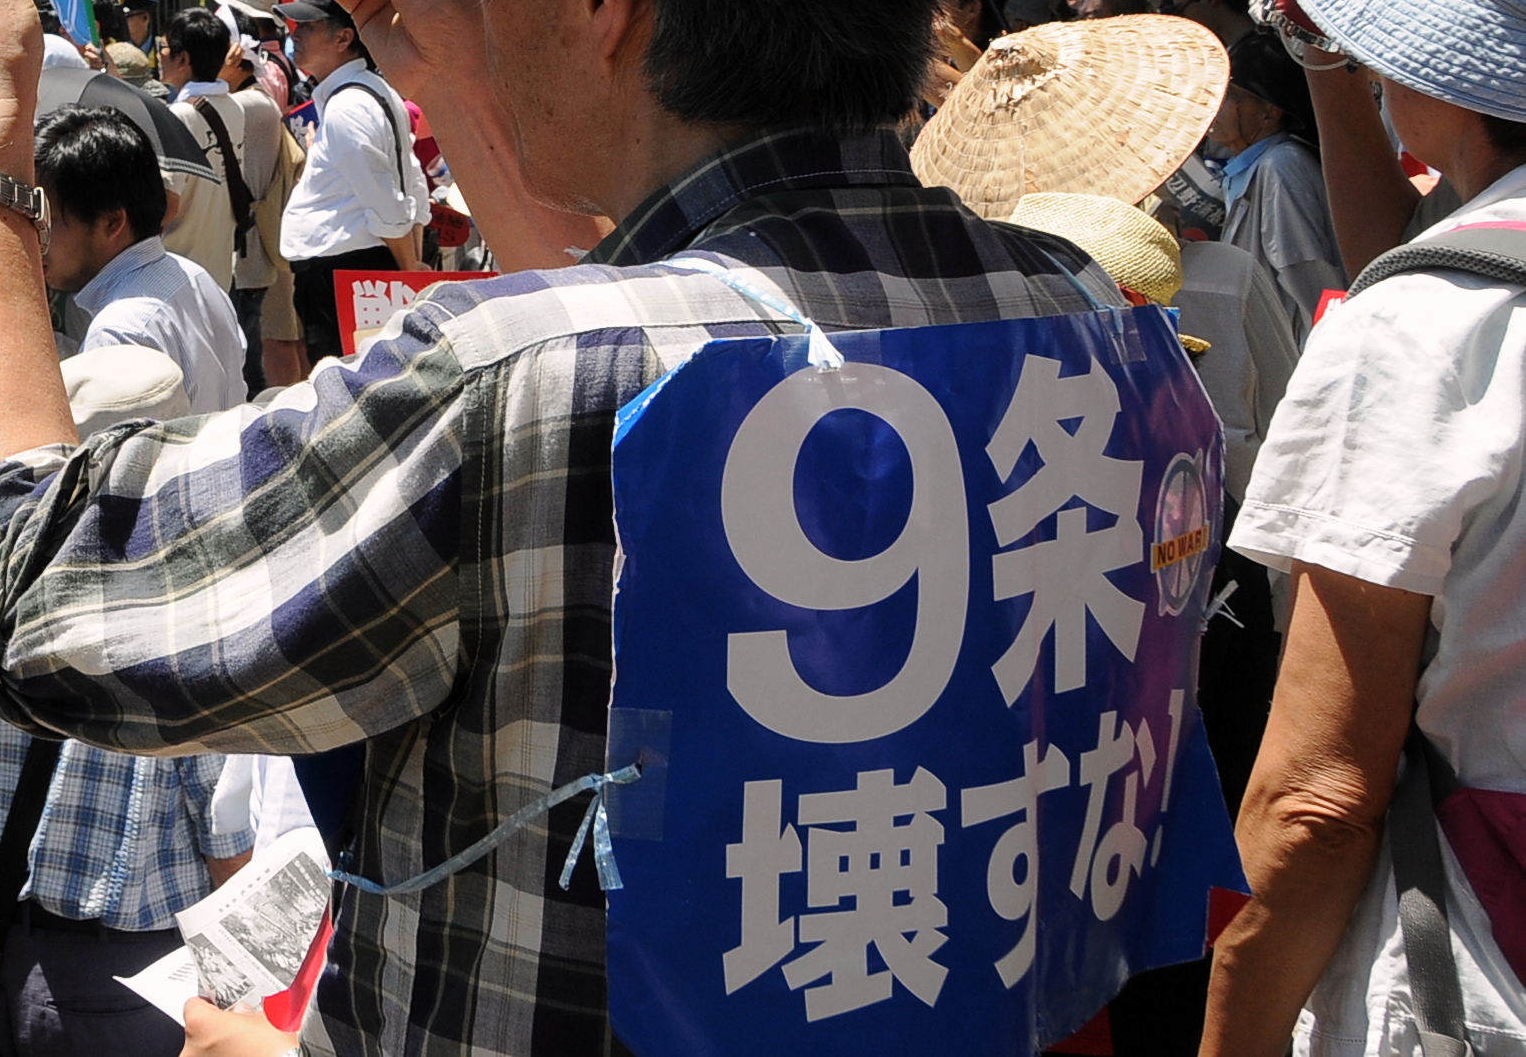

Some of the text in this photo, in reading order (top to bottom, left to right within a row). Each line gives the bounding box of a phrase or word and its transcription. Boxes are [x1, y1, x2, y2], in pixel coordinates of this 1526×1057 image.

[721, 353, 1147, 743] 9条
[1156, 542, 1175, 566] NO
[722, 688, 1185, 1023] 壊すな!
